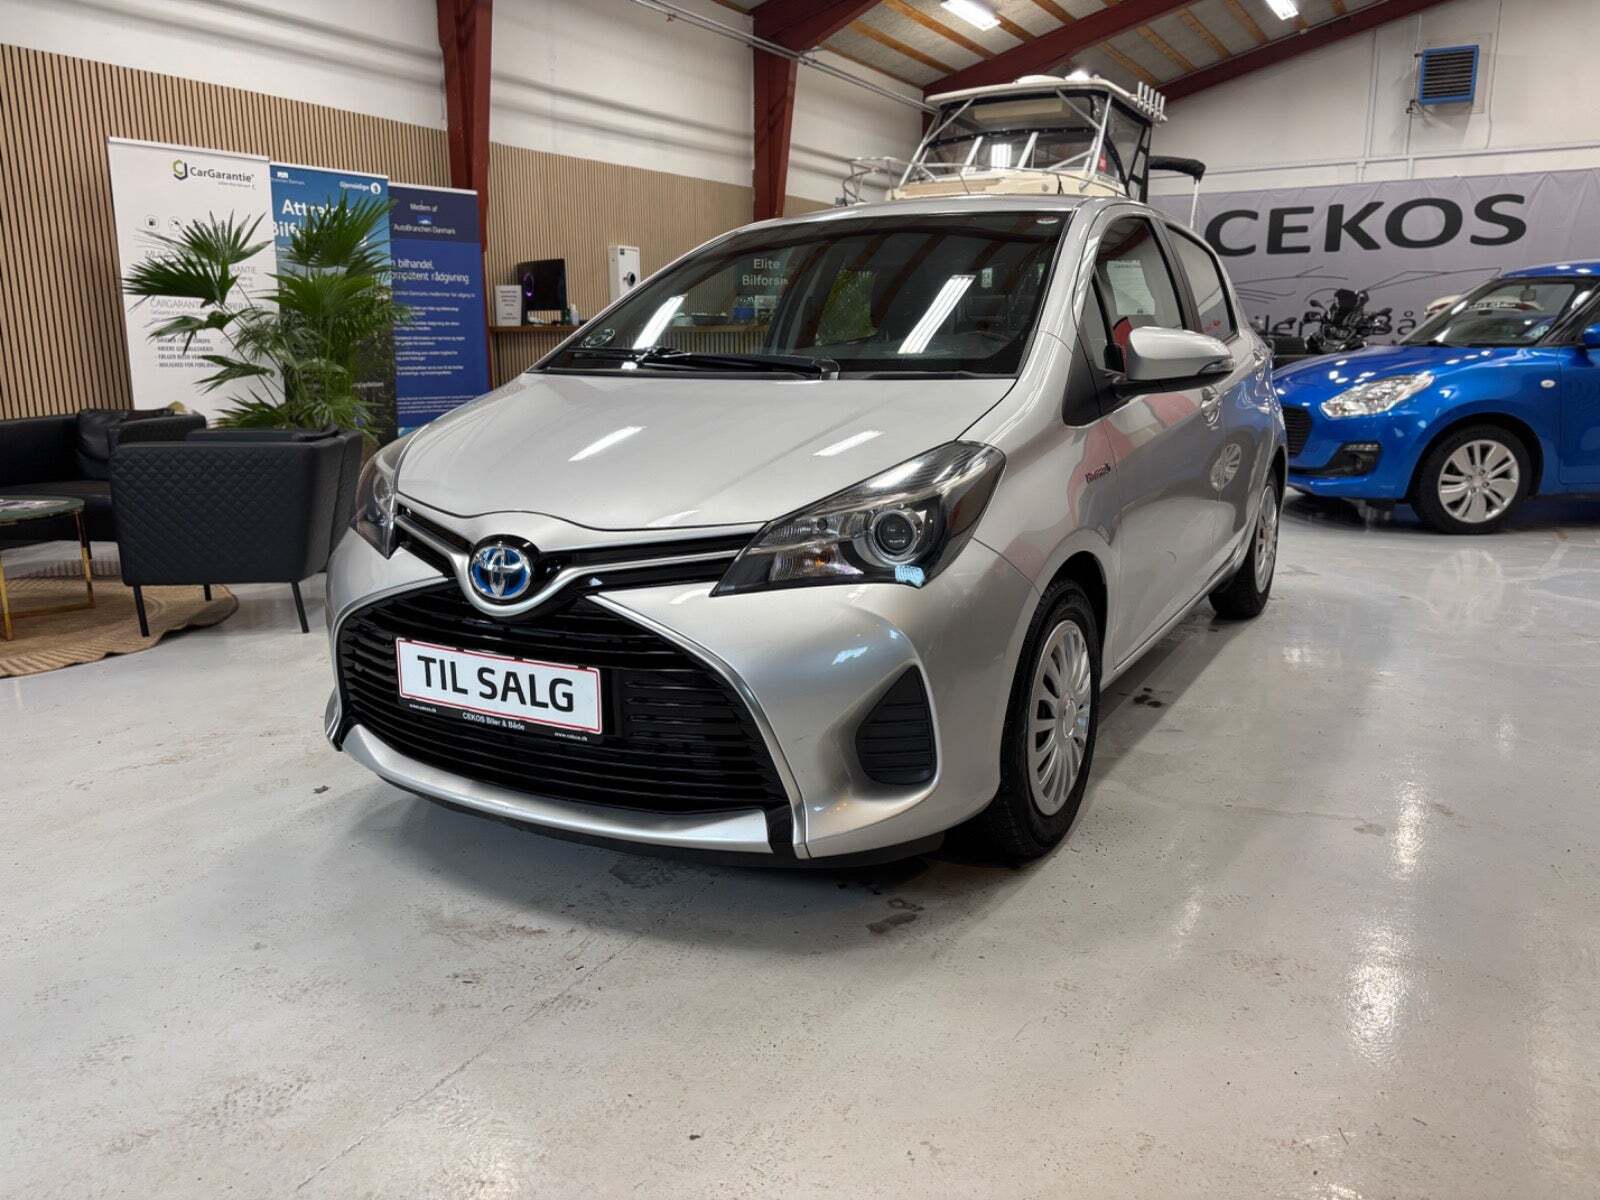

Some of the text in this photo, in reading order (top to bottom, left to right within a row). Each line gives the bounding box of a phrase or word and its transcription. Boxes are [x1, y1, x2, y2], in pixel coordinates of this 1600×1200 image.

[190, 166, 252, 182] CarGarantie
[1204, 193, 1528, 257] CEKOS
[753, 258, 781, 269] Elite
[417, 655, 574, 713] TIL SALG
[462, 711, 486, 724] CEKOS
[487, 715, 501, 727] Biler
